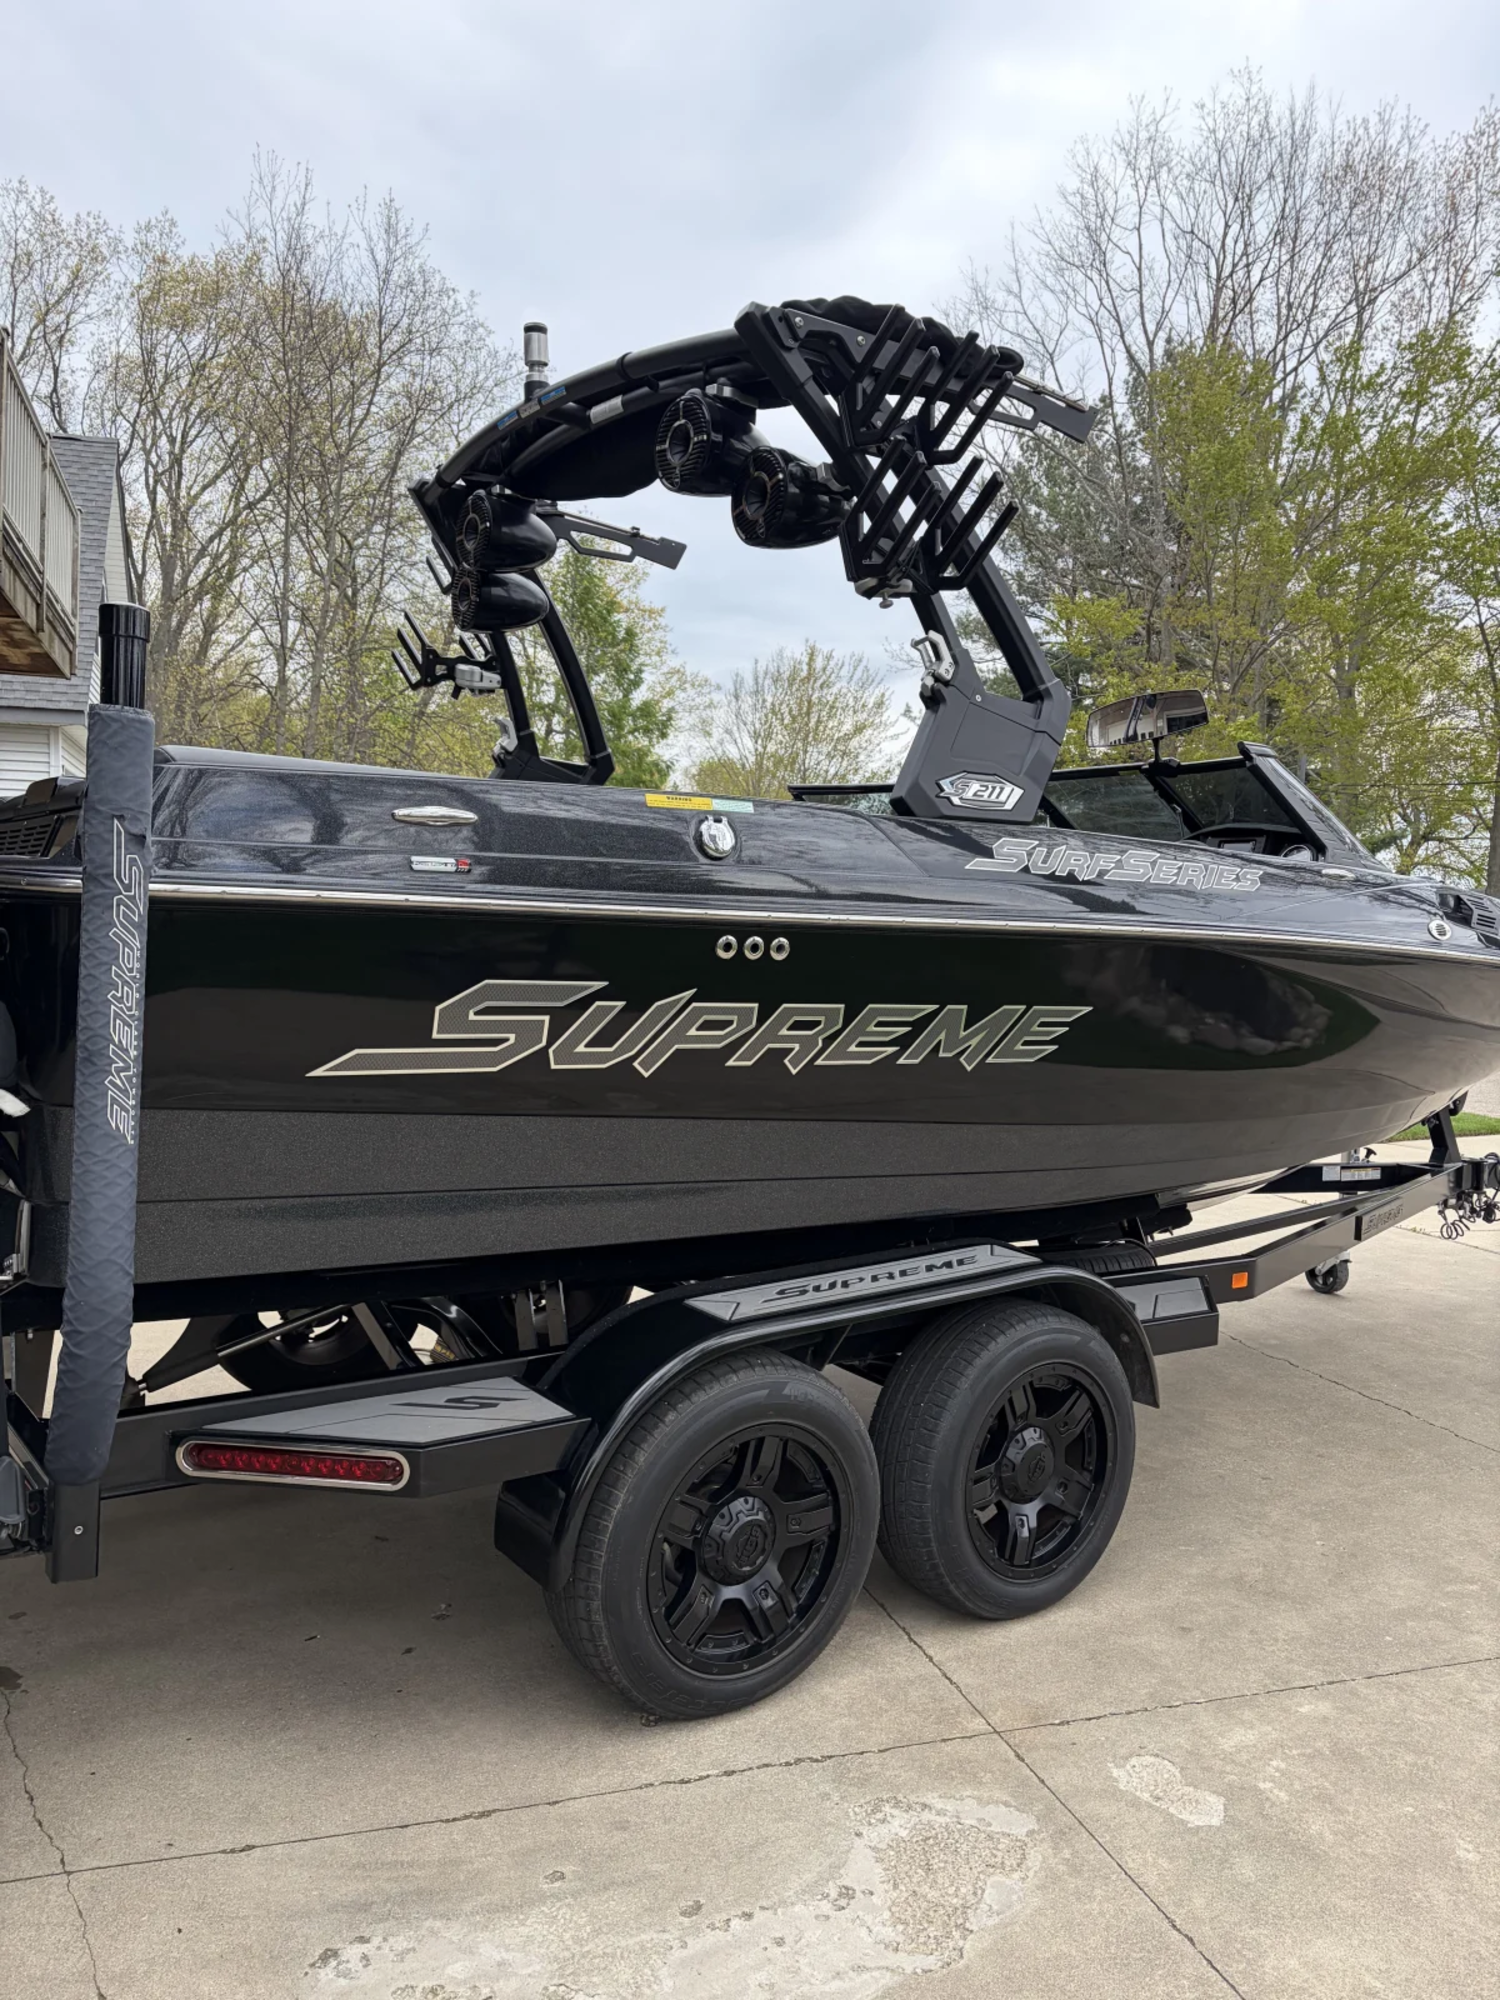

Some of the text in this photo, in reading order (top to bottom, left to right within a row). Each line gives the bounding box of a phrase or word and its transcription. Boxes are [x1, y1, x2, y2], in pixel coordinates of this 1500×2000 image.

[104, 819, 144, 1144] SUPREME
[305, 979, 1094, 1077] SUPREME
[760, 1254, 977, 1303] SUPREME
